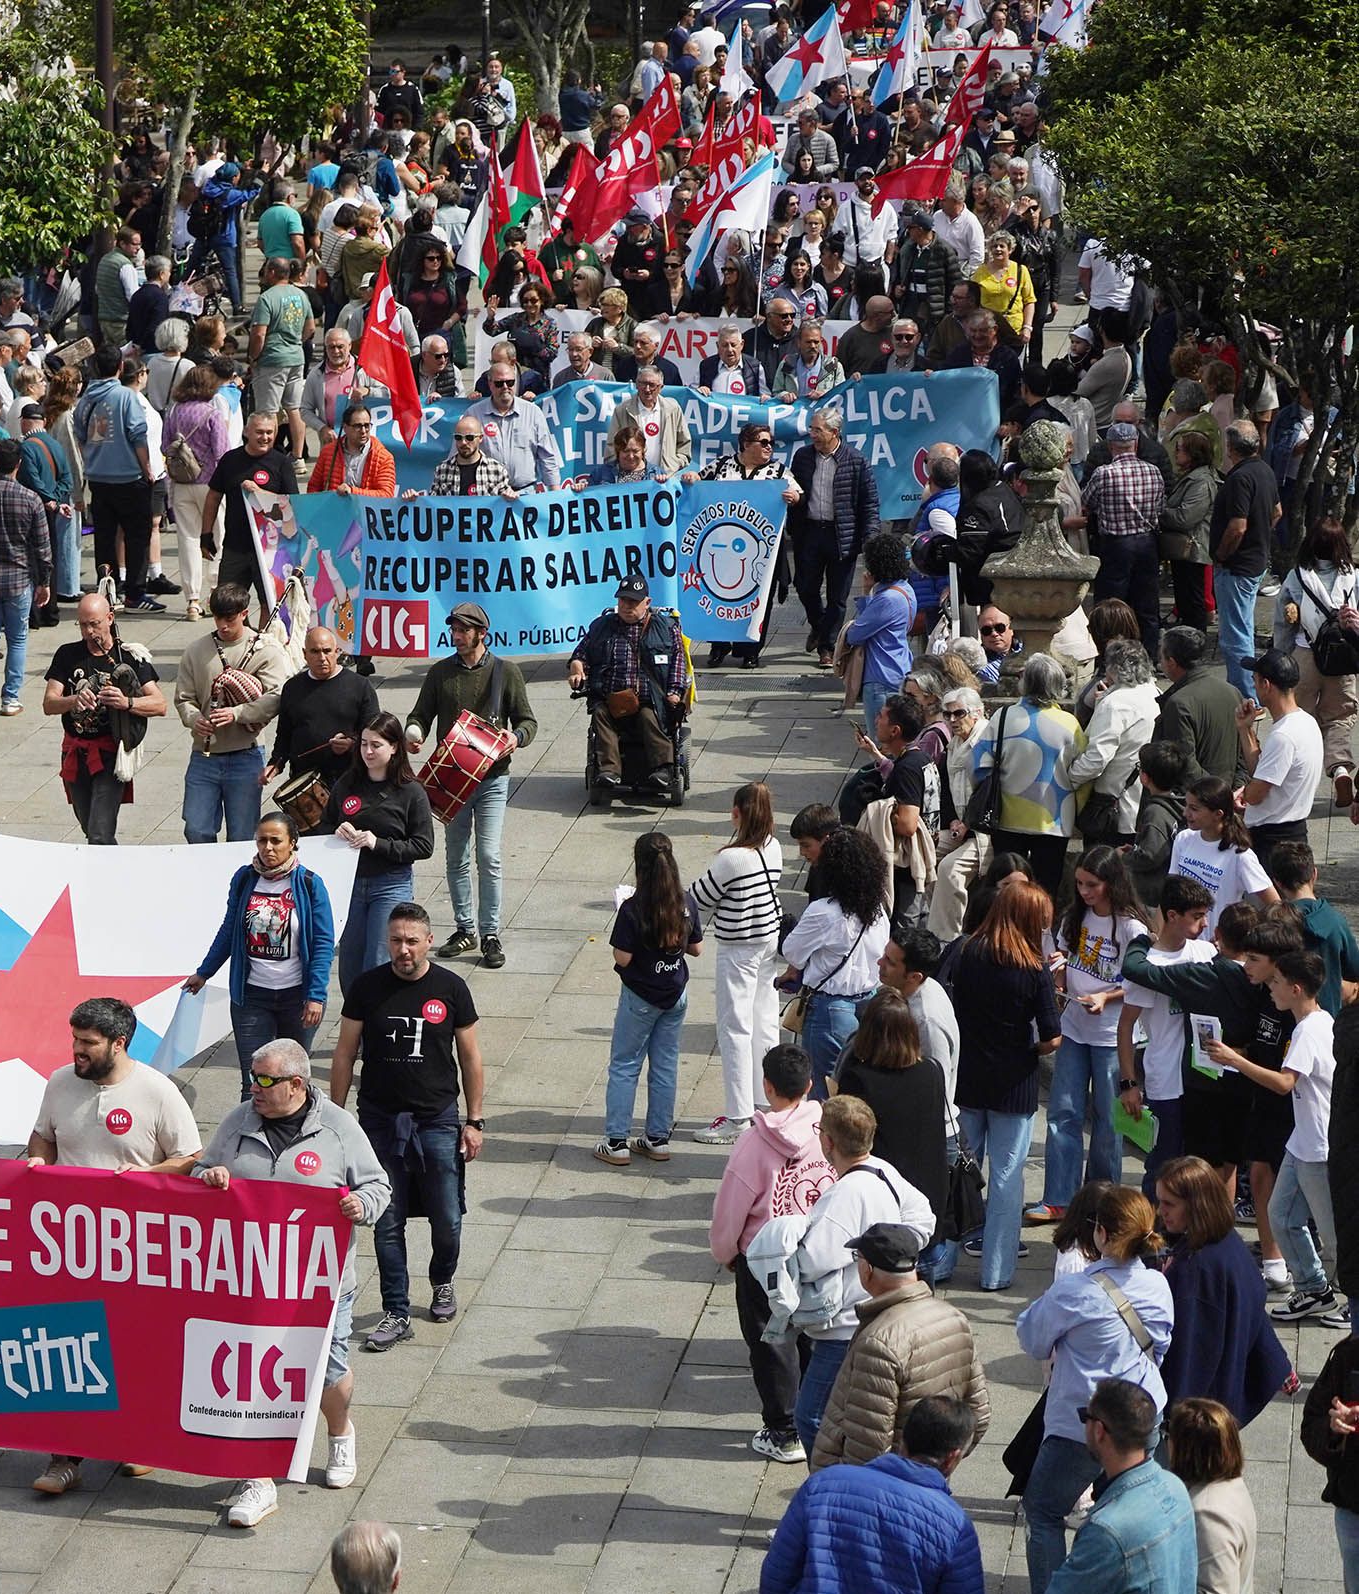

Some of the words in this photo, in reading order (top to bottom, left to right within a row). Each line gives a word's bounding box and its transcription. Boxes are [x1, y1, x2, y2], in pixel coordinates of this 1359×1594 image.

[364, 505, 539, 544] RECUPERAR
[547, 490, 681, 537] DEREITO
[681, 503, 726, 556] SERVIZOS
[728, 501, 778, 552] PÚBLICO
[364, 555, 539, 594] RECUPERAR
[364, 605, 425, 650] CIG
[520, 624, 588, 645] PÚBLICA
[1183, 857, 1223, 876] CAMPOLONGO
[427, 1004, 442, 1014] CIG
[111, 1114, 127, 1124] CIG
[301, 1155, 317, 1167] CIG
[29, 1200, 343, 1300] SOBERANÍA
[210, 1340, 307, 1402] CIG
[188, 1403, 242, 1419] Confederación
[244, 1410, 298, 1420] Intersindical
